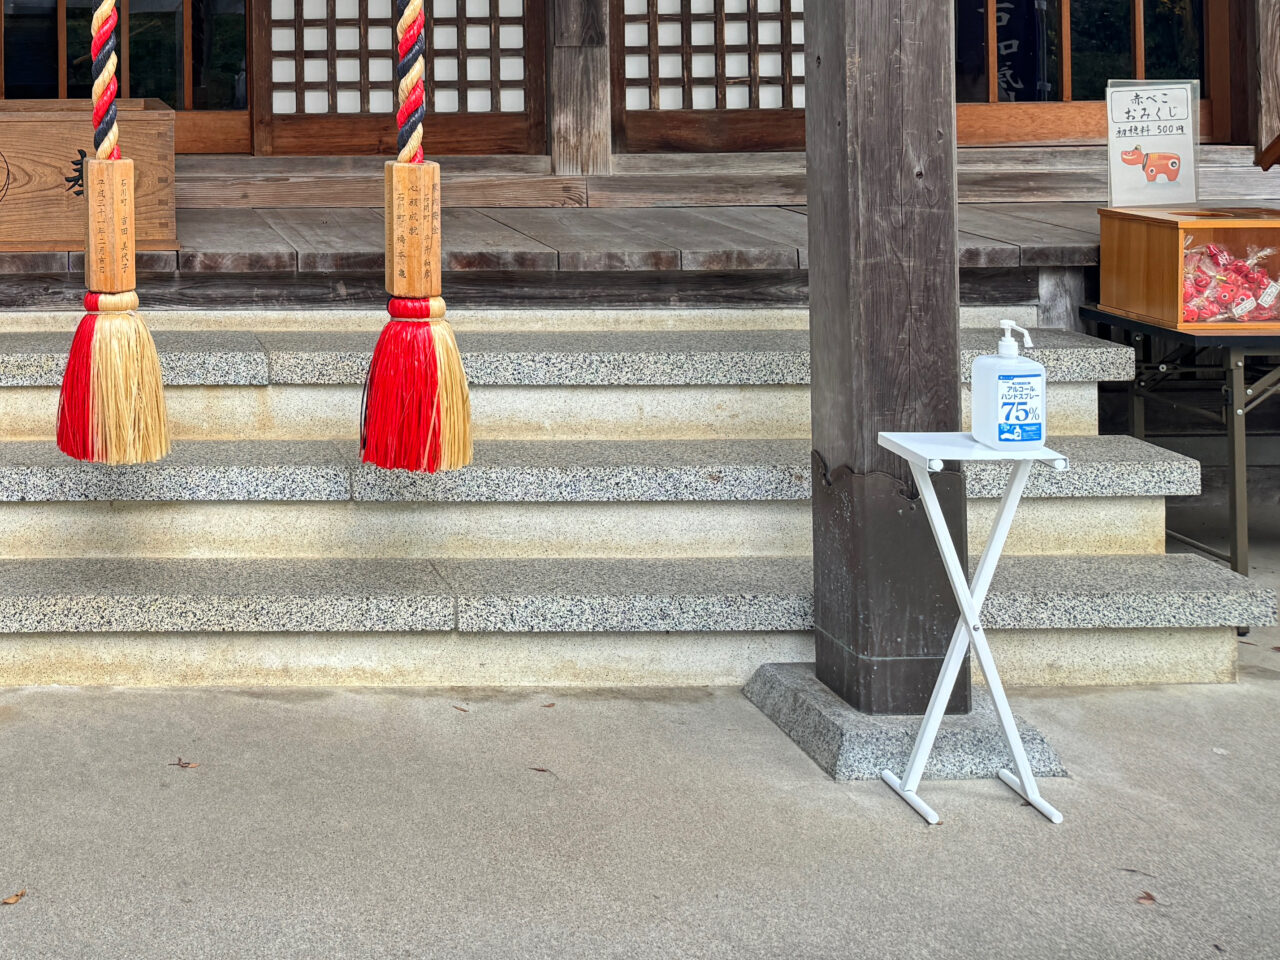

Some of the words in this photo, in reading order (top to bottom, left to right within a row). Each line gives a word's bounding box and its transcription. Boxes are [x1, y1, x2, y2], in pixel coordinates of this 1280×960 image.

[1130, 92, 1169, 106] 赤べこ
[1123, 106, 1179, 121] おみくじ
[1115, 124, 1151, 137] 初穂料
[1156, 124, 1185, 134] 500円
[1006, 385, 1036, 393] アルコール
[1001, 401, 1040, 422] 75%
